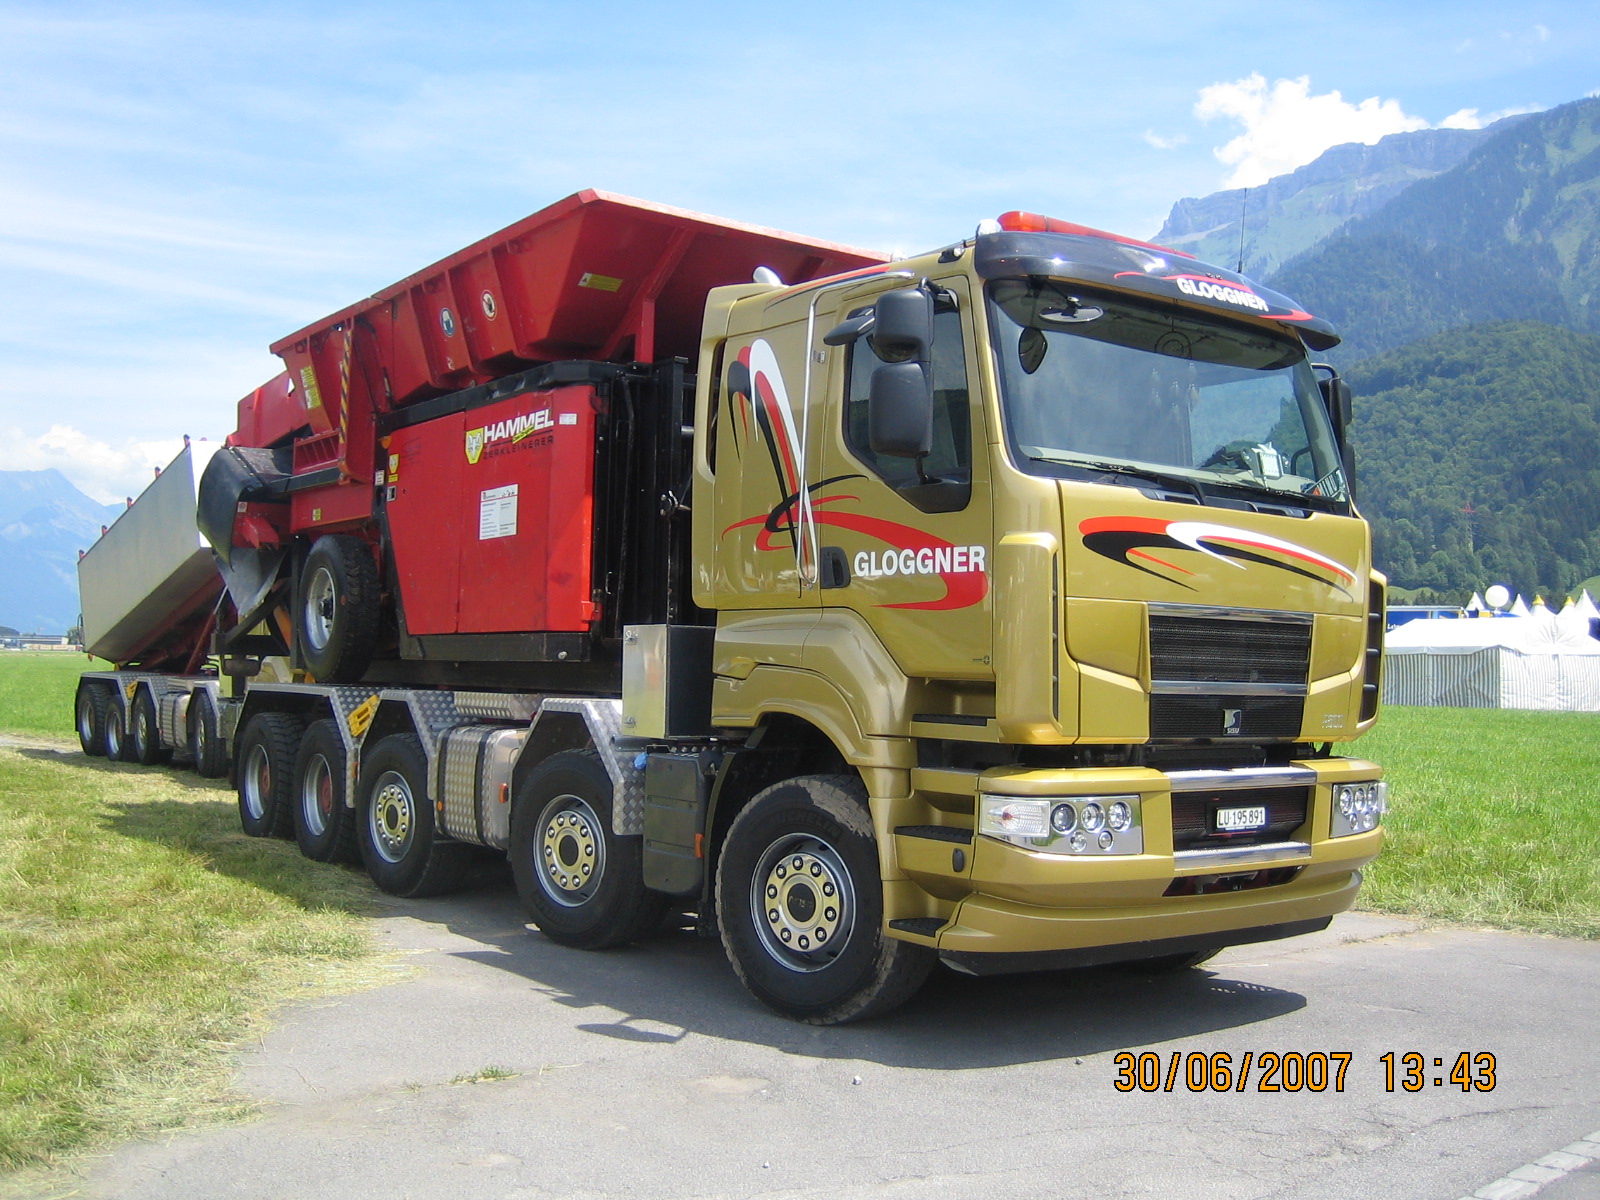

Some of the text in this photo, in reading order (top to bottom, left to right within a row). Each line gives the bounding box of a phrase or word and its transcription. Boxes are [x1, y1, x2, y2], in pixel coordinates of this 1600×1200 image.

[1176, 278, 1270, 312] GLOGGNER
[484, 408, 554, 444] HAMMEL
[483, 435, 554, 460] ZERKLEINERER
[854, 545, 986, 577] GLOGGNER
